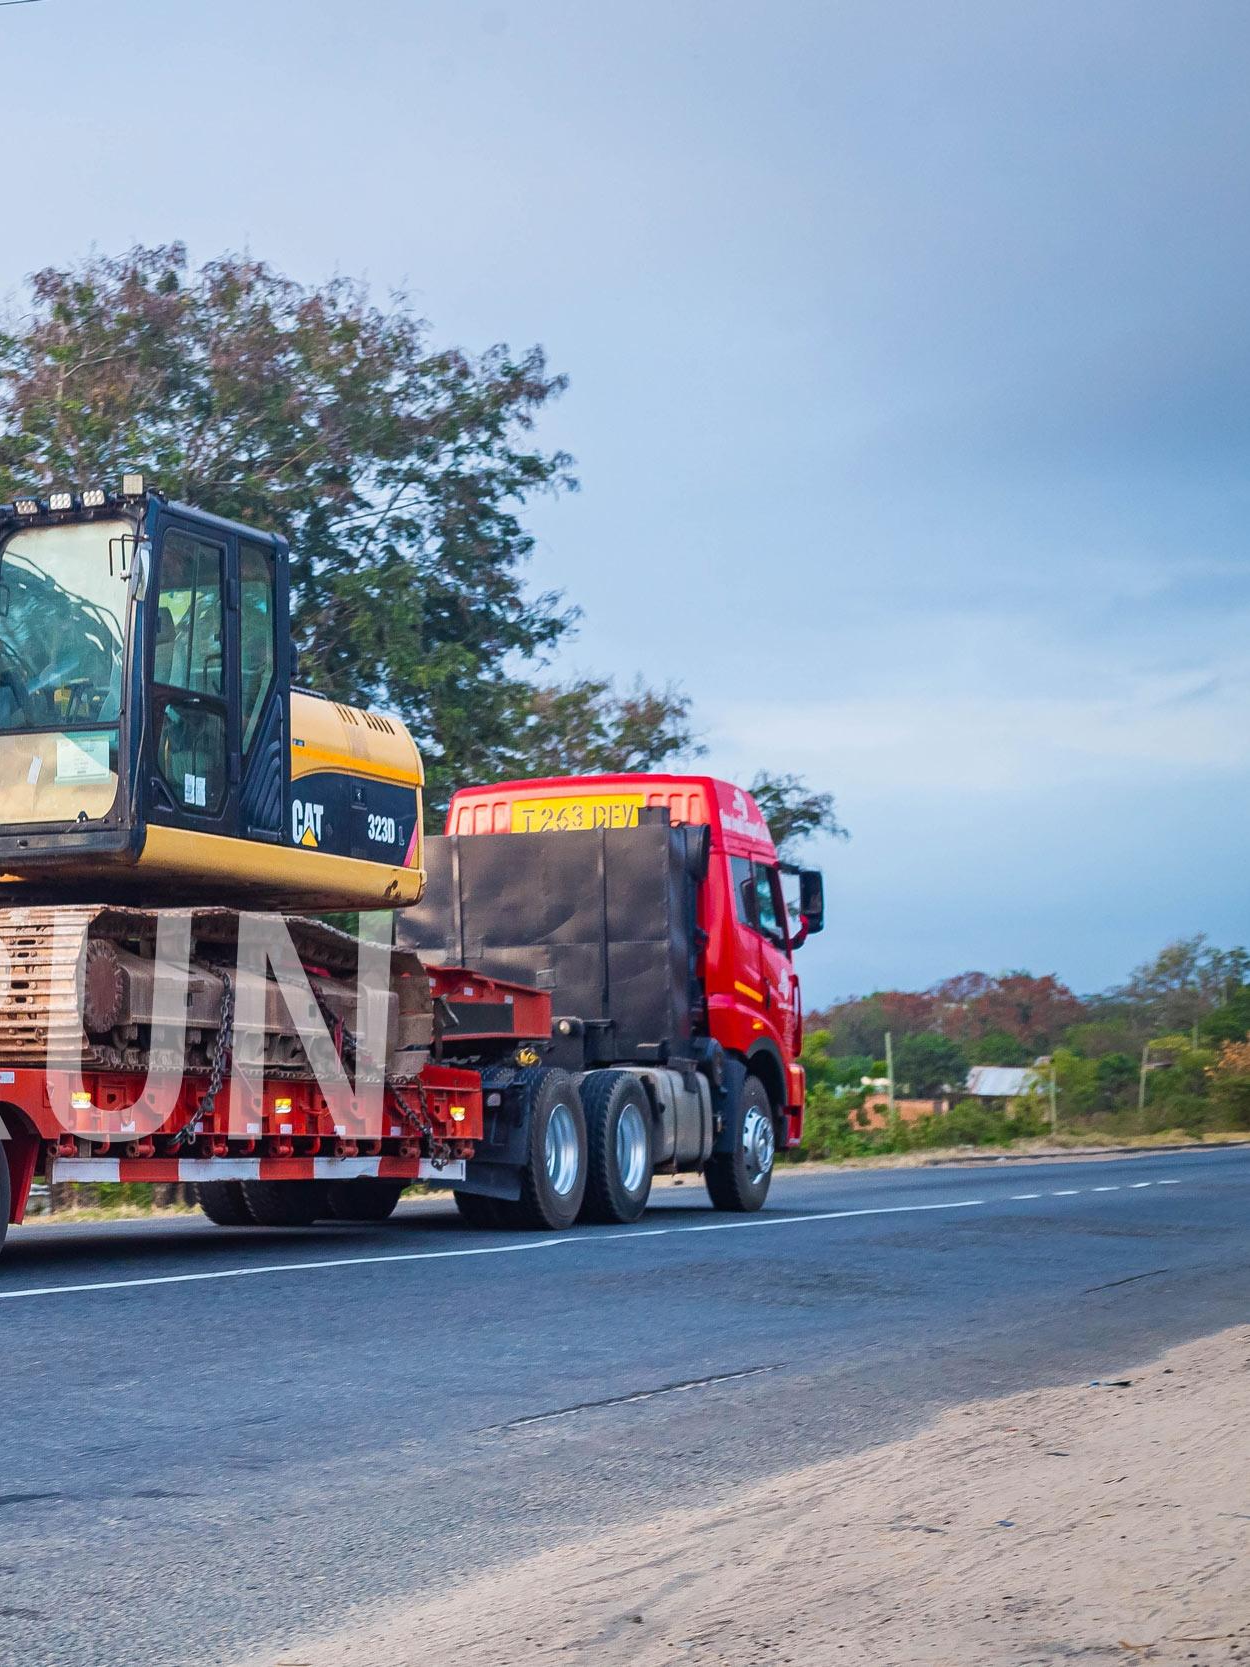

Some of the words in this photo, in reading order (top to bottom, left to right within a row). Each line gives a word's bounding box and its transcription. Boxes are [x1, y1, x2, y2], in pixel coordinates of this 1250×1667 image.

[292, 799, 324, 844] CAT
[367, 813, 396, 844] 323D
[522, 809, 535, 832] T
[541, 805, 583, 831] 263
